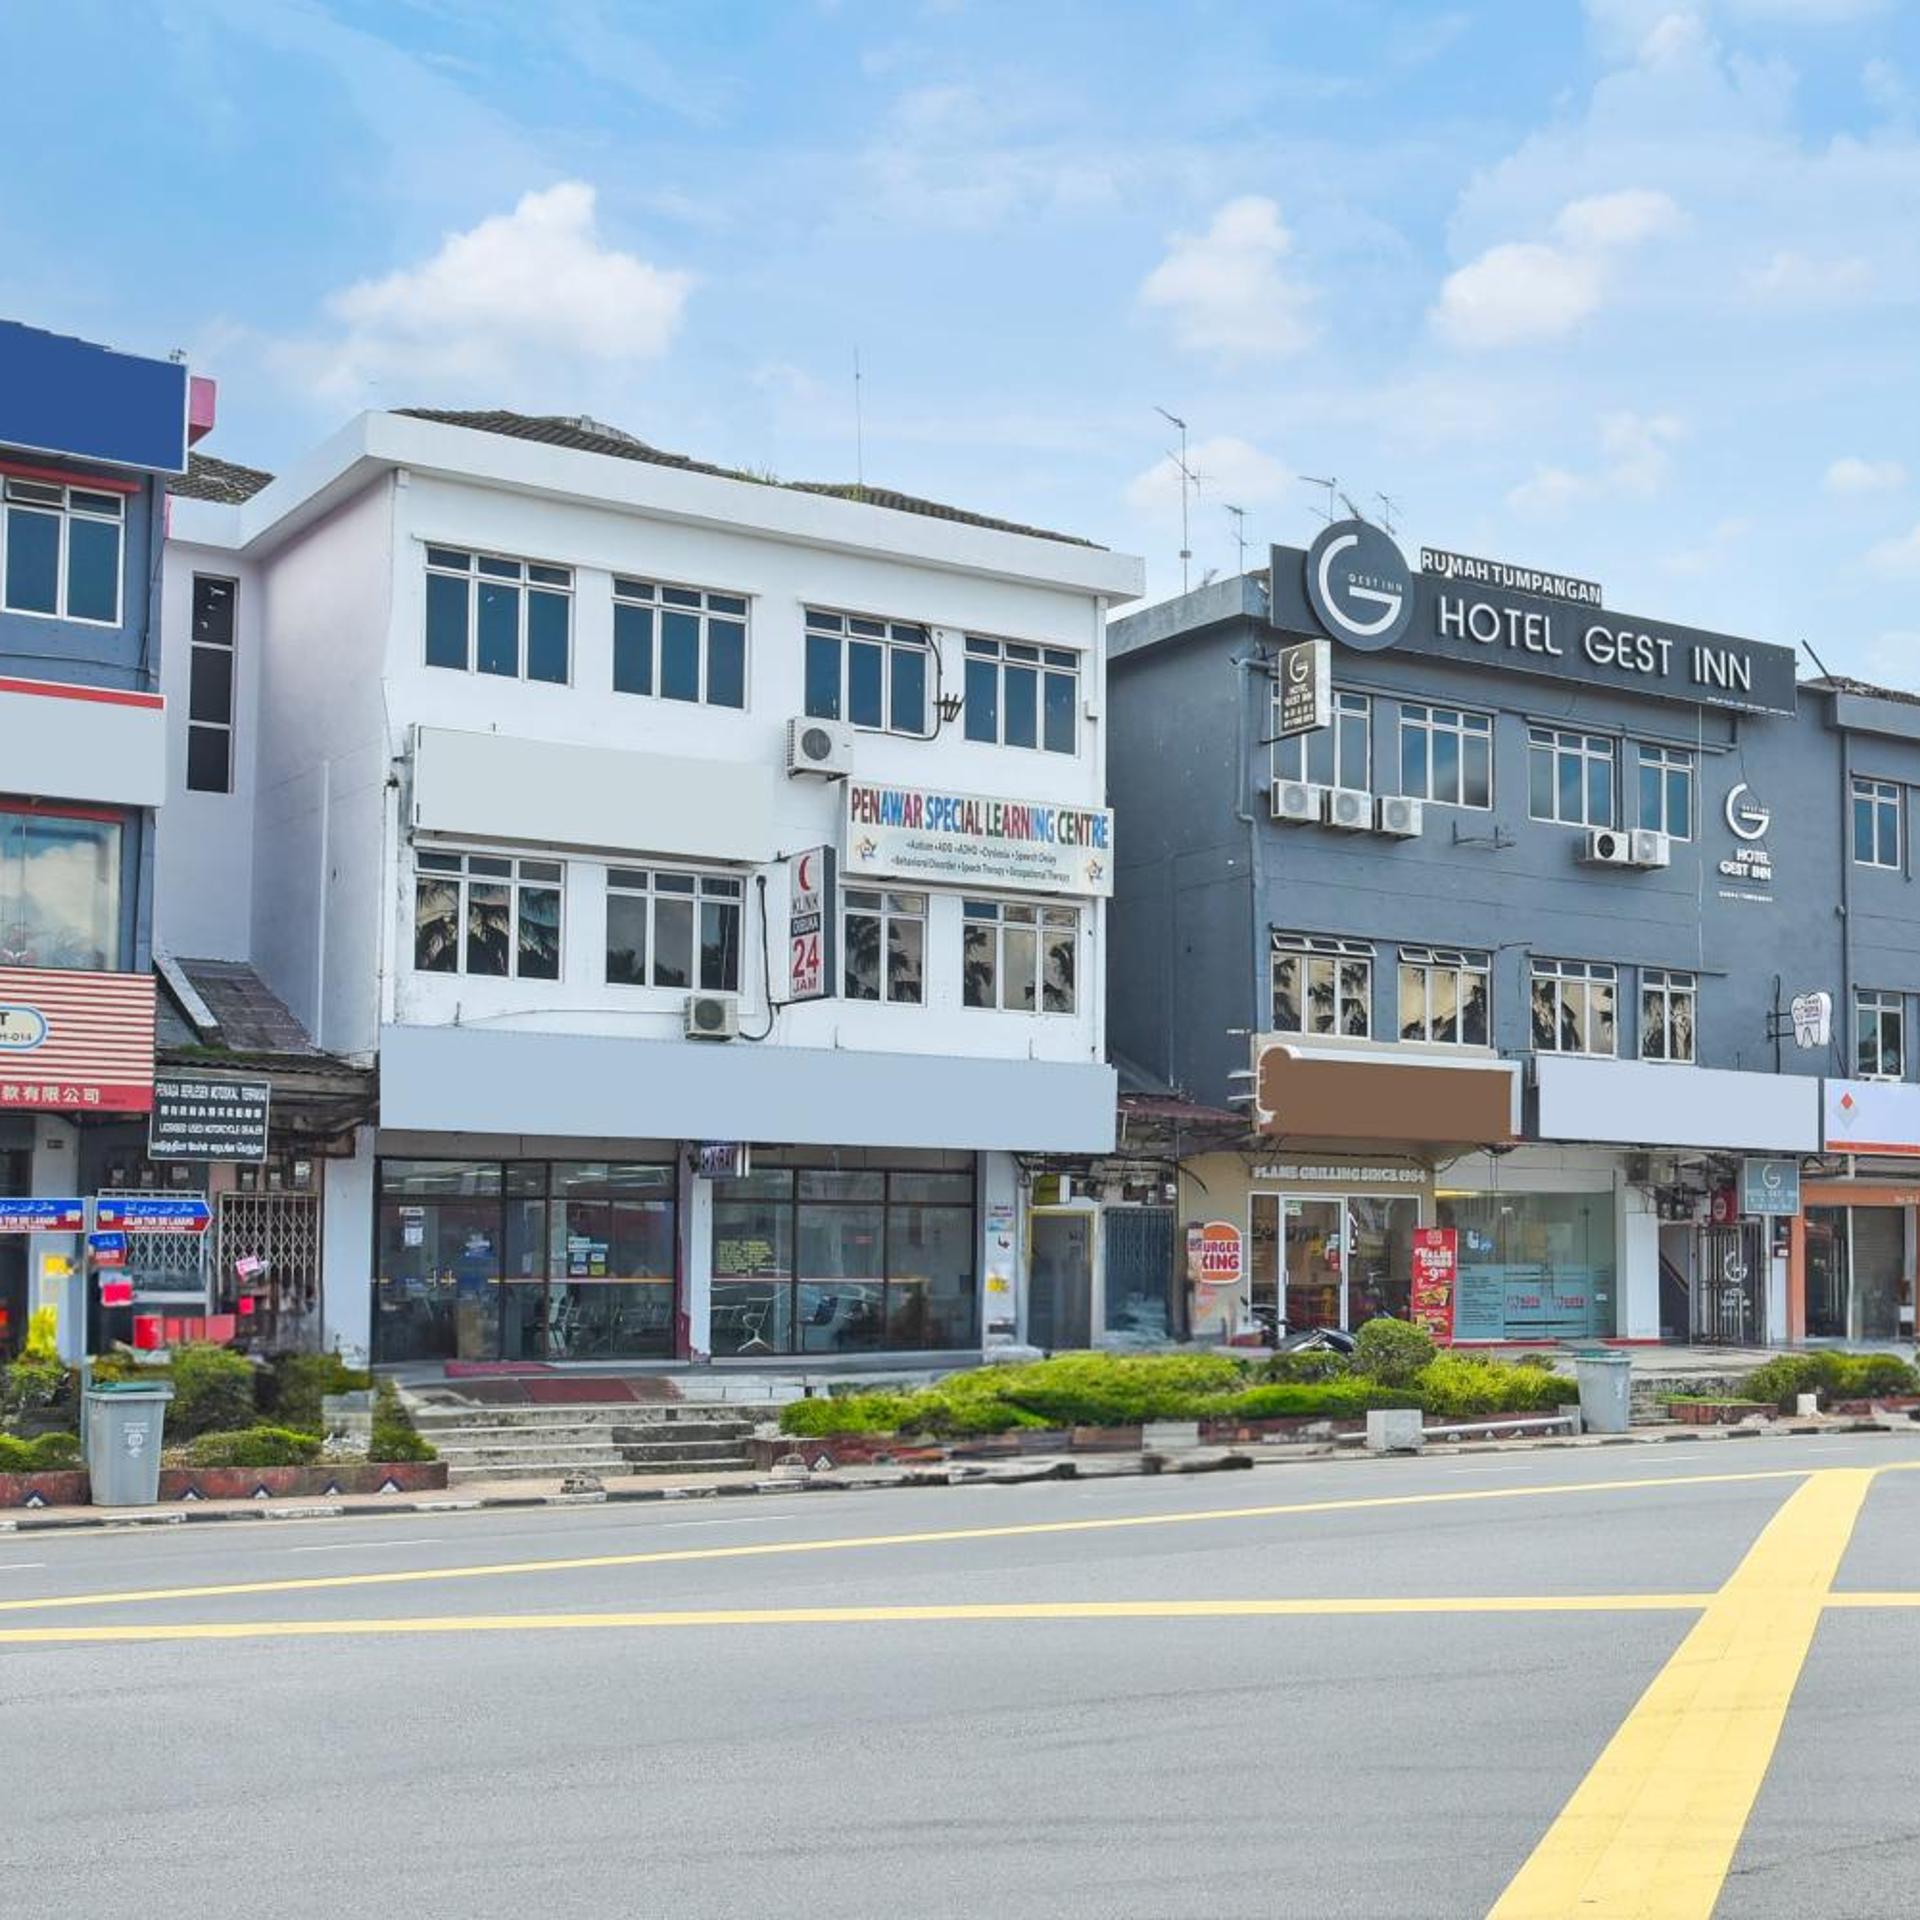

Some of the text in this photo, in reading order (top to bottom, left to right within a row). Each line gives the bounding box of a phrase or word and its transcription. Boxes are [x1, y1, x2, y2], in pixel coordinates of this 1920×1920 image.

[1421, 551, 1601, 604] RUMAH TUMPANGAN
[1440, 595, 1751, 692] HOTEL GEST INN
[851, 787, 1109, 850] PENAWAR SPECIAL LEARNING CENTRE
[793, 934, 819, 978] 24
[793, 976, 817, 992] JAM
[1203, 1241, 1240, 1252] URGER
